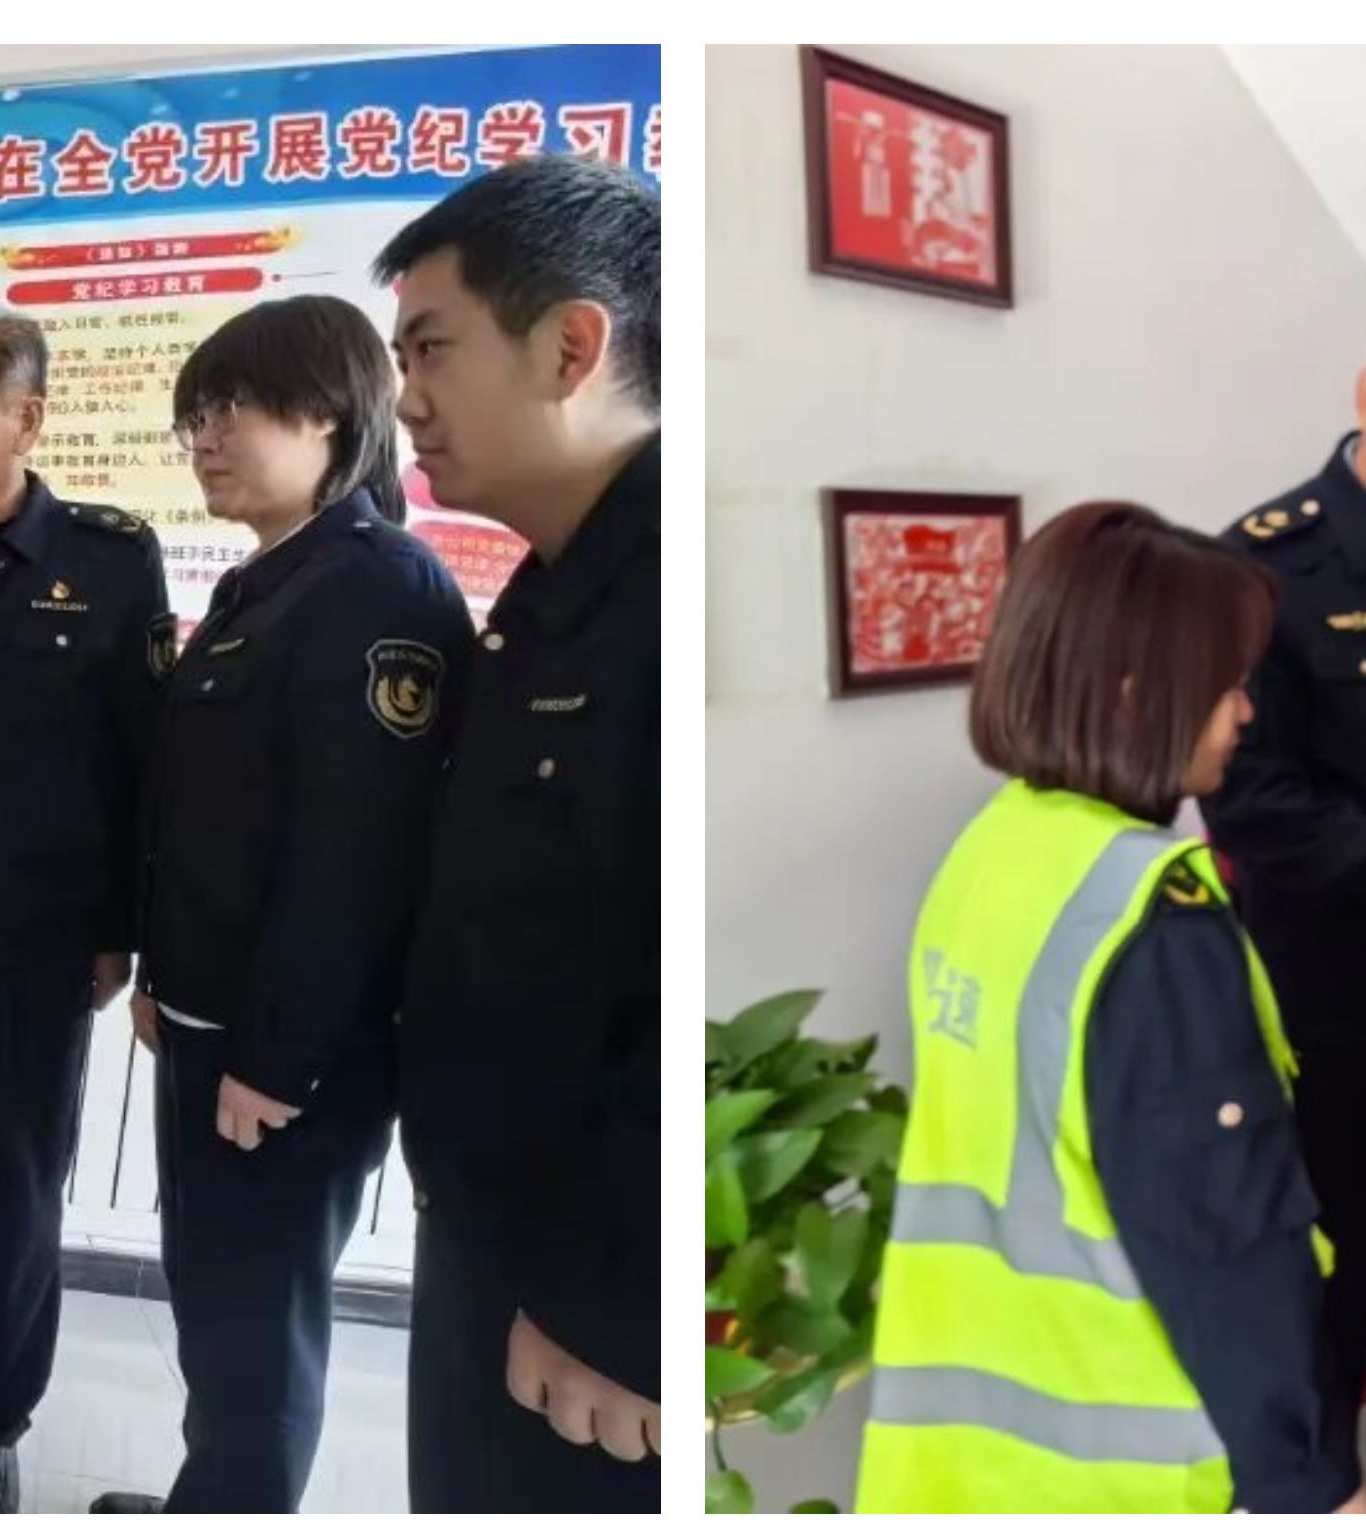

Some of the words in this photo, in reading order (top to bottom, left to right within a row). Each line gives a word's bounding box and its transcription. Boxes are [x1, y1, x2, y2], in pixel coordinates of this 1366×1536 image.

[72, 273, 206, 300] 党纪学习教育
